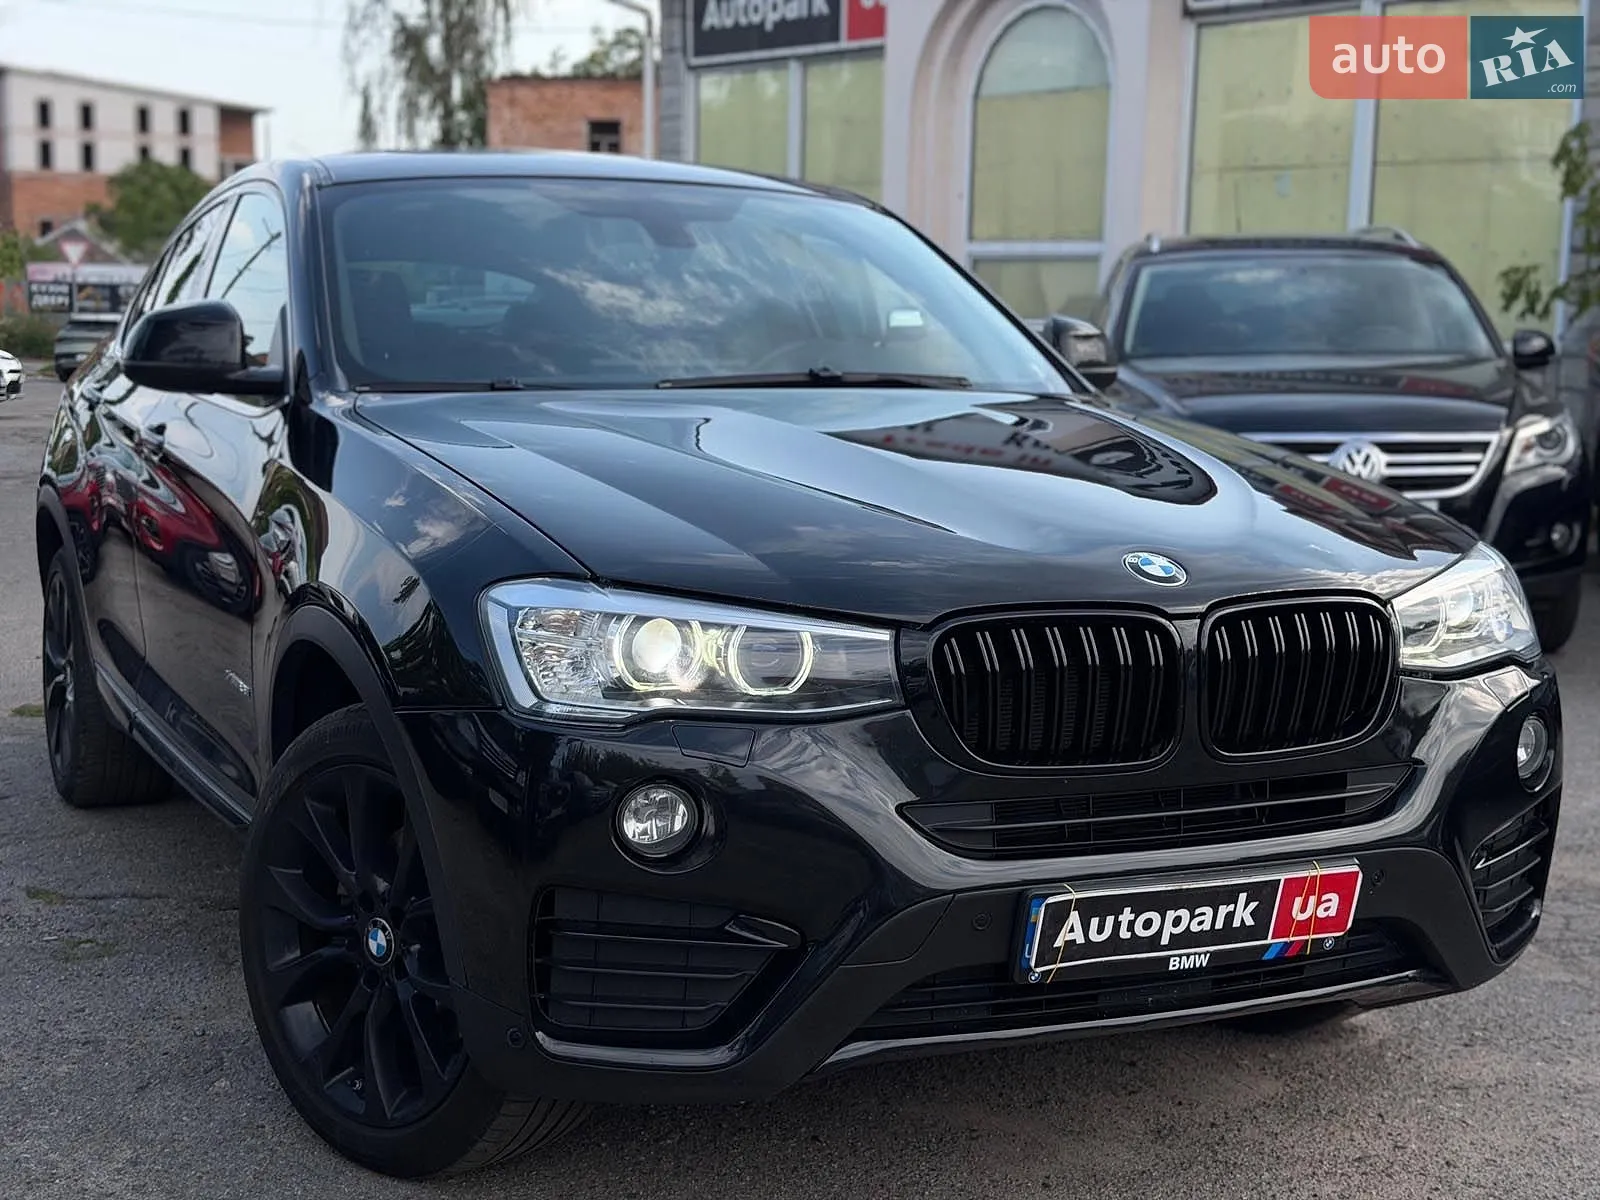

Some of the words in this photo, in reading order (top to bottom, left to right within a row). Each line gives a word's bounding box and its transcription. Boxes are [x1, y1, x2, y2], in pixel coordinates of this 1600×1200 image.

[701, 0, 830, 32] Autopark
[1053, 892, 1260, 947] Autopark
[1291, 891, 1339, 922] ua
[1168, 953, 1211, 971] BMW
